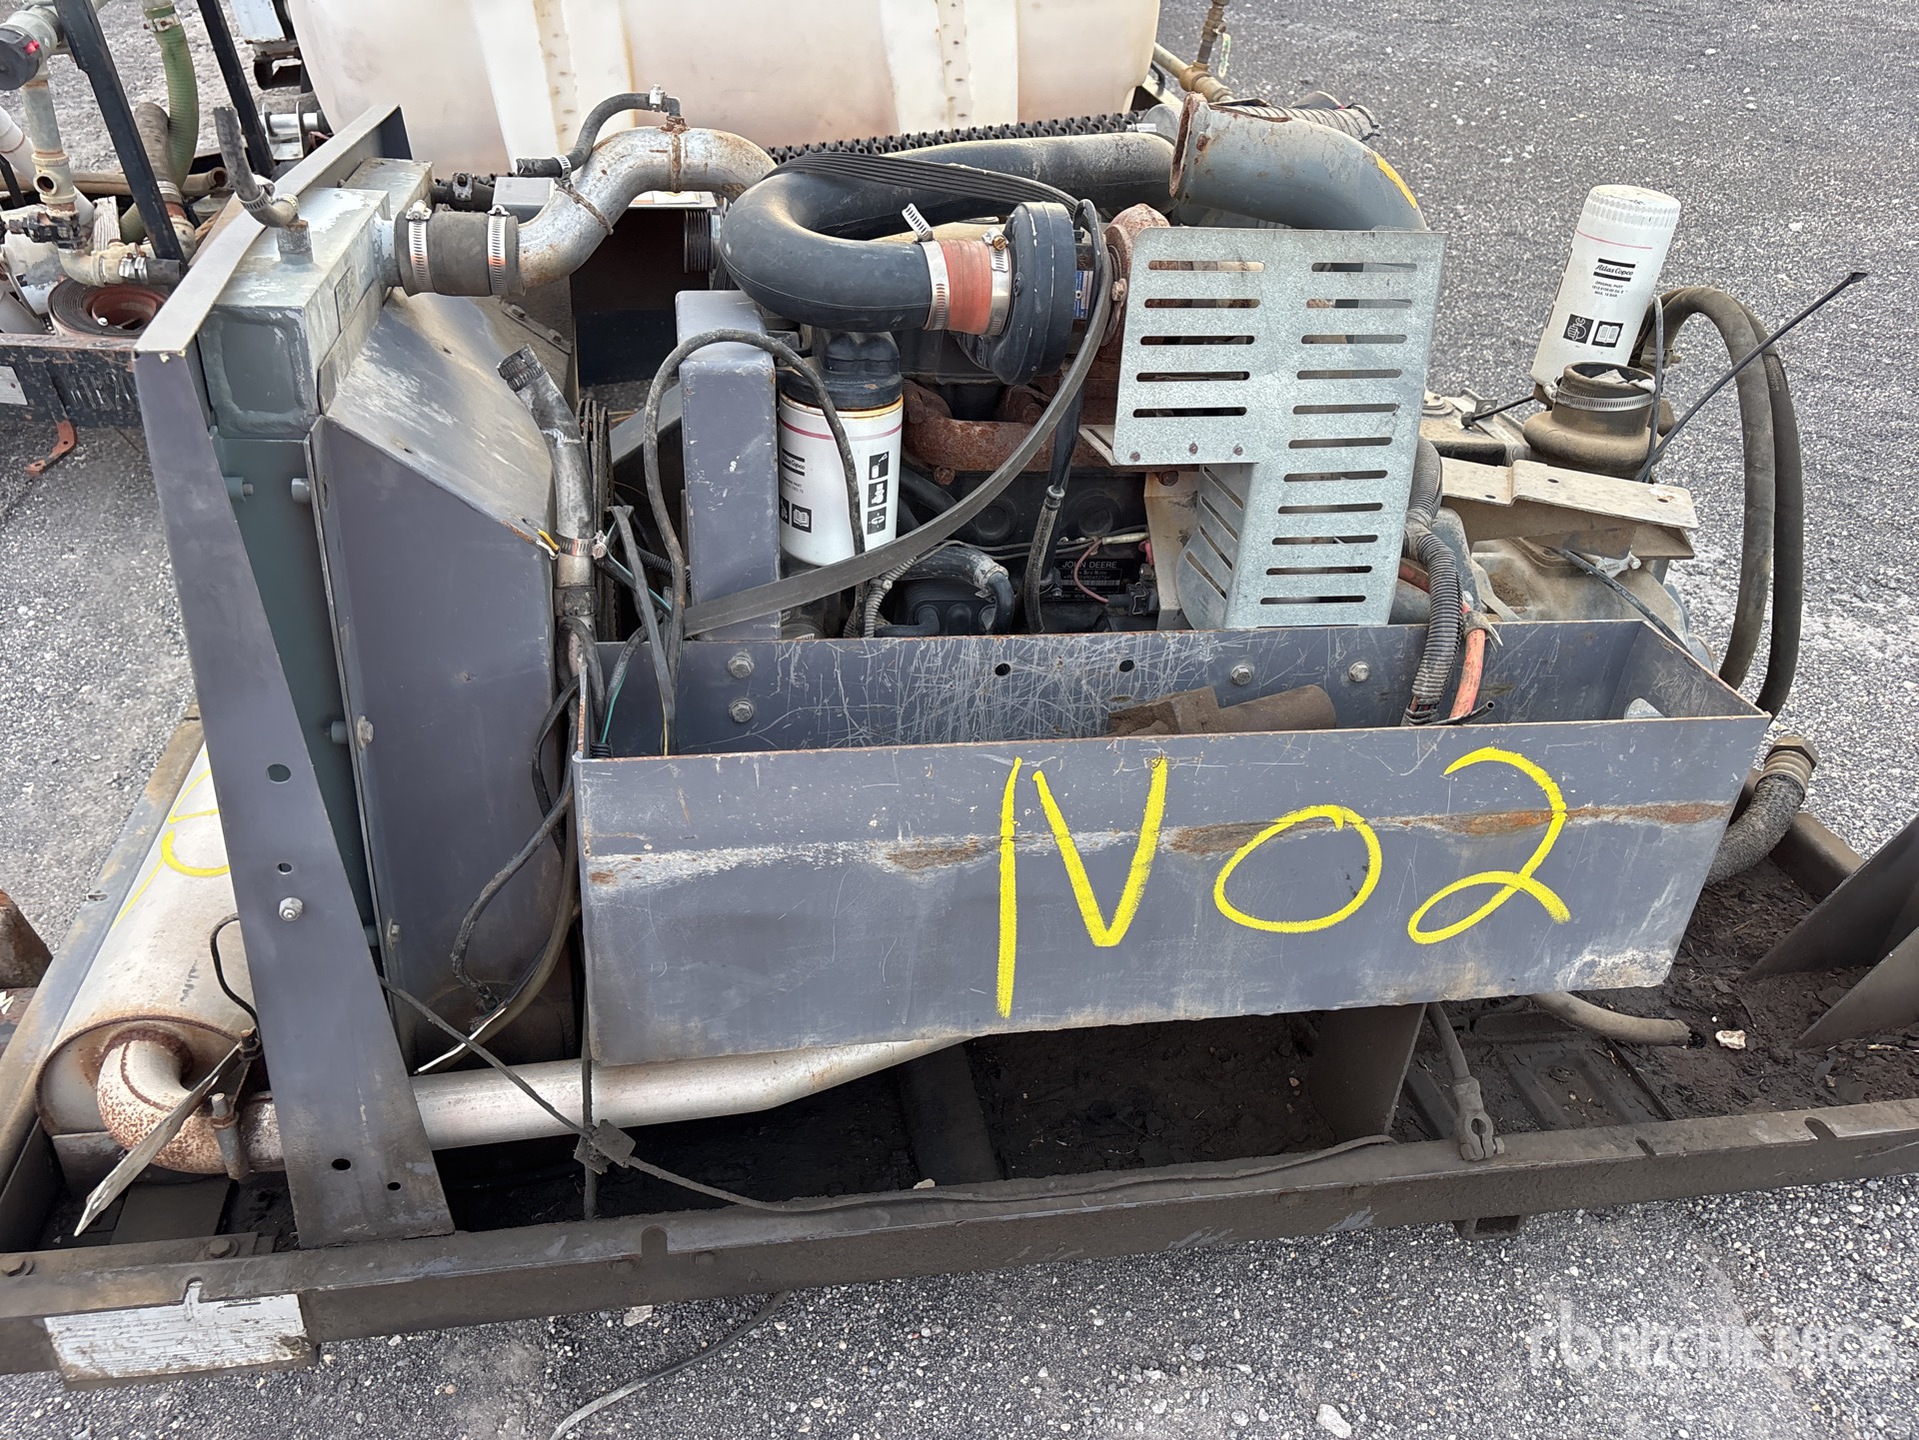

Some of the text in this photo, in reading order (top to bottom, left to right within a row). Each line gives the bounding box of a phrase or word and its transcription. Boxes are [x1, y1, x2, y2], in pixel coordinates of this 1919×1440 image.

[1595, 264, 1633, 276] Atlas Copco
[791, 460, 805, 470] Copco
[1089, 561, 1117, 569] DEERE
